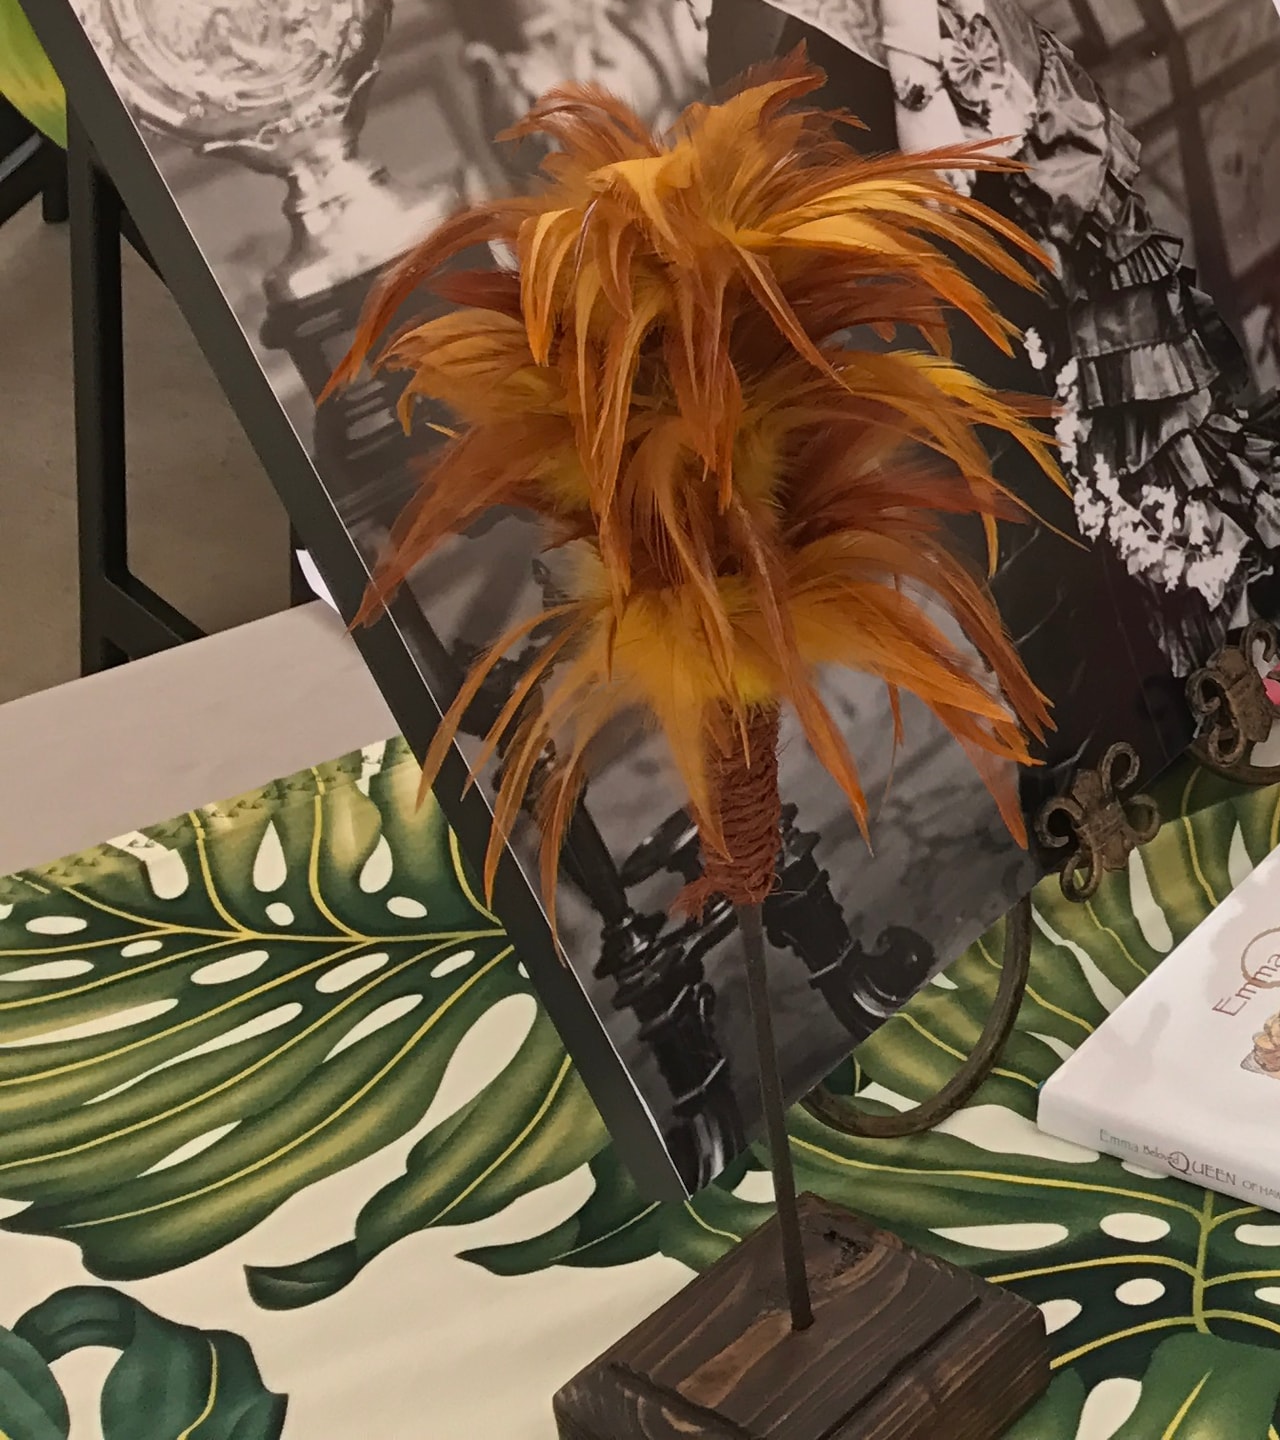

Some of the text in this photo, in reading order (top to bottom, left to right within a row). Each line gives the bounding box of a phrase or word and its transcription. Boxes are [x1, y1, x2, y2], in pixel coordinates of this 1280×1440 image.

[1100, 1128, 1139, 1152] Emma
[1143, 1145, 1179, 1164] Beloved
[1168, 1151, 1236, 1185] QUEEN
